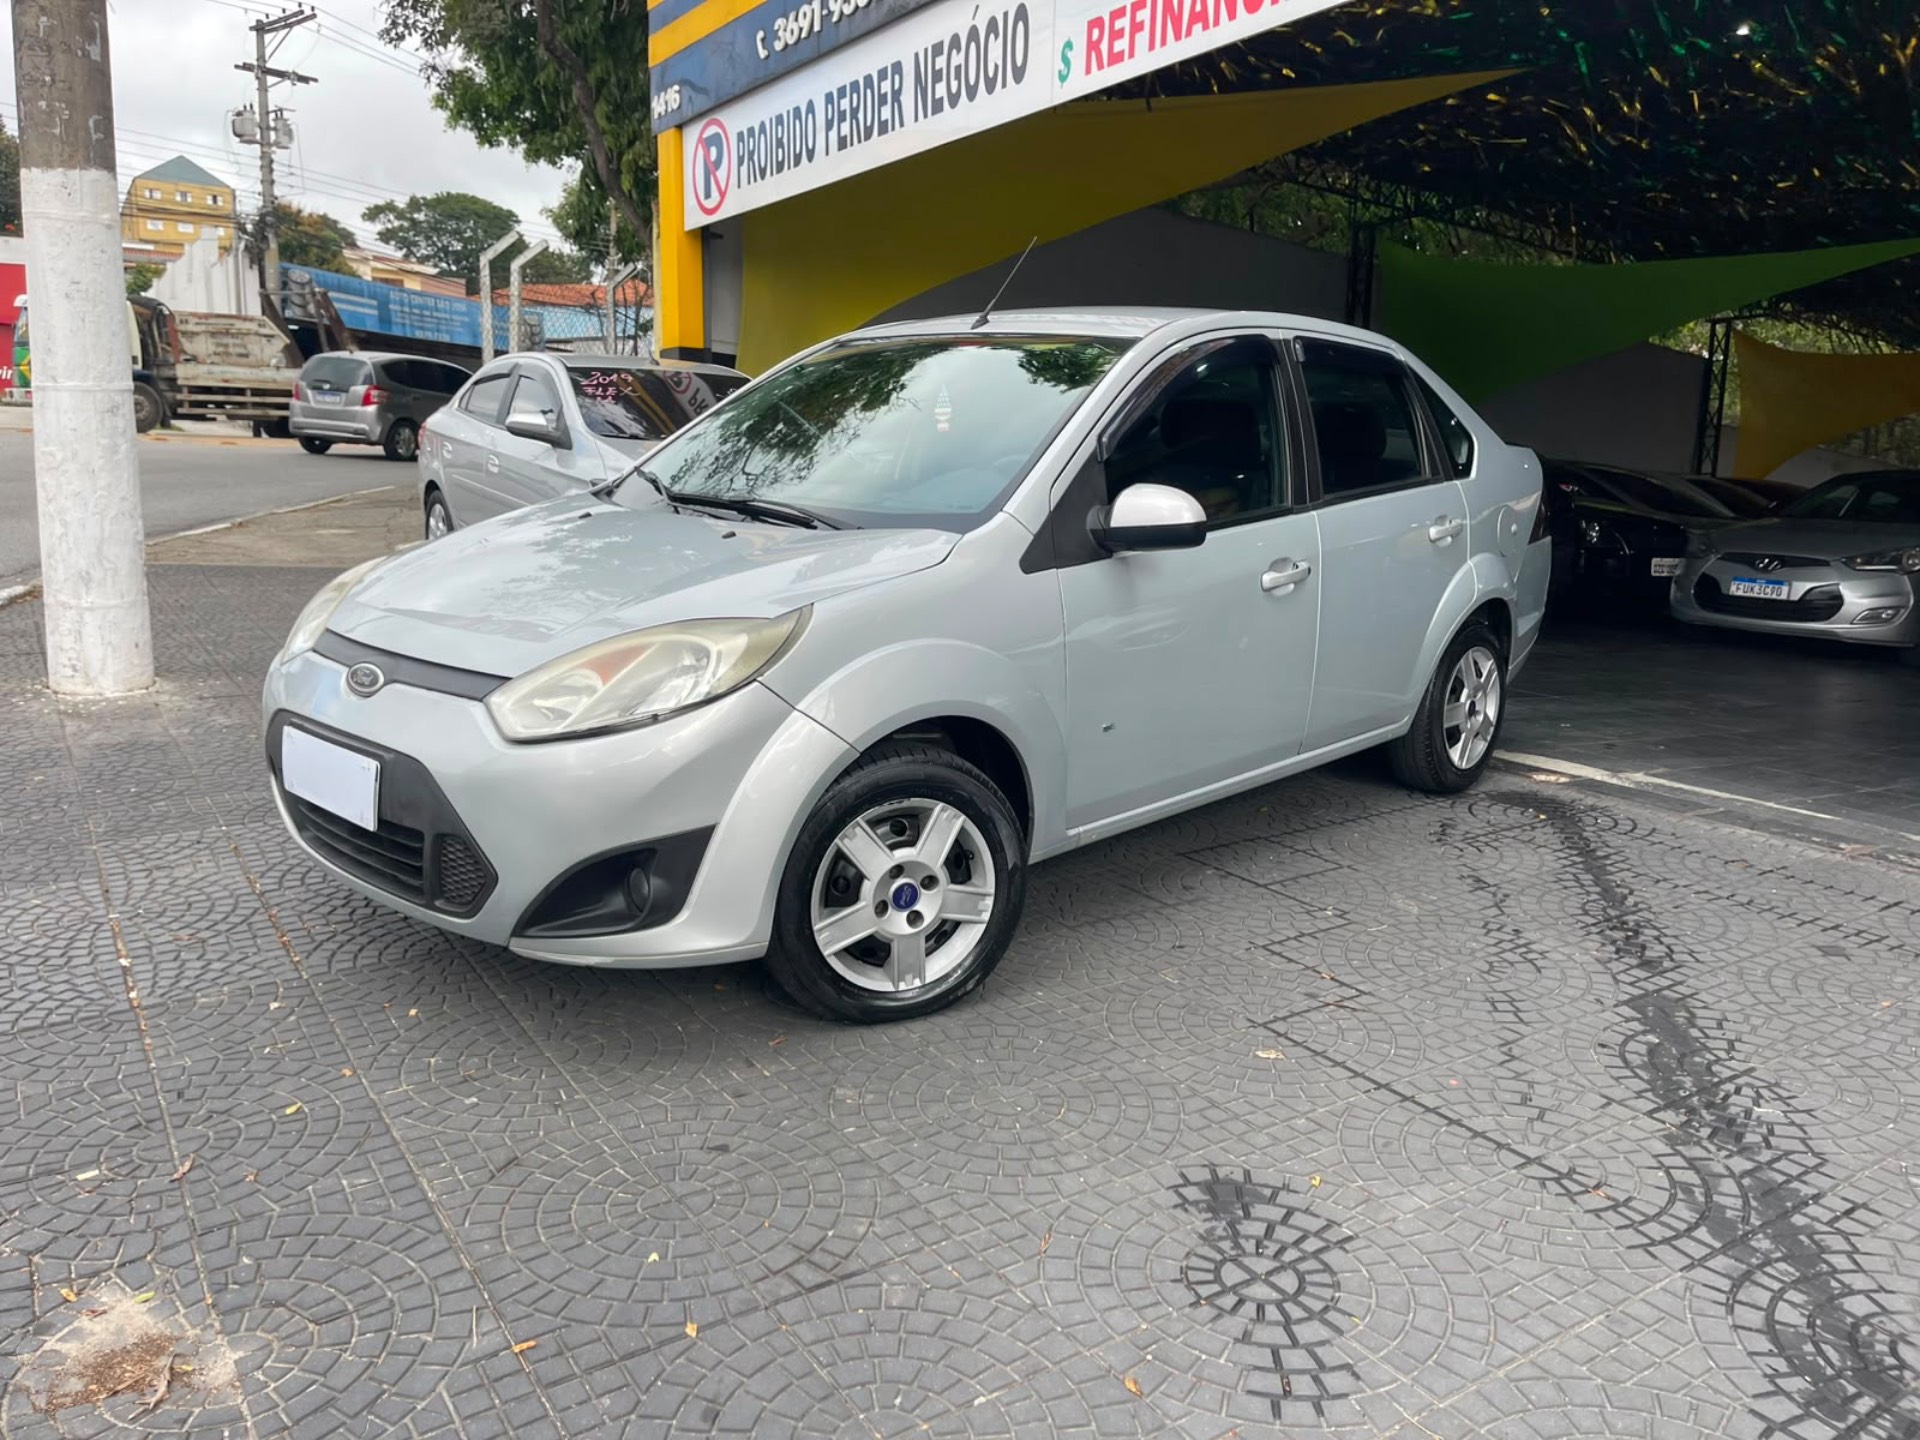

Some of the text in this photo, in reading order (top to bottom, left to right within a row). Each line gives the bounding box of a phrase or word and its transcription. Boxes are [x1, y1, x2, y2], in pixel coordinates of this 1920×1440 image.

[651, 84, 681, 119] 1416
[736, 3, 1030, 189] PROIBIDO PERDER NEGÓCIO
[580, 371, 633, 385] 2019
[581, 385, 641, 397] FLEX
